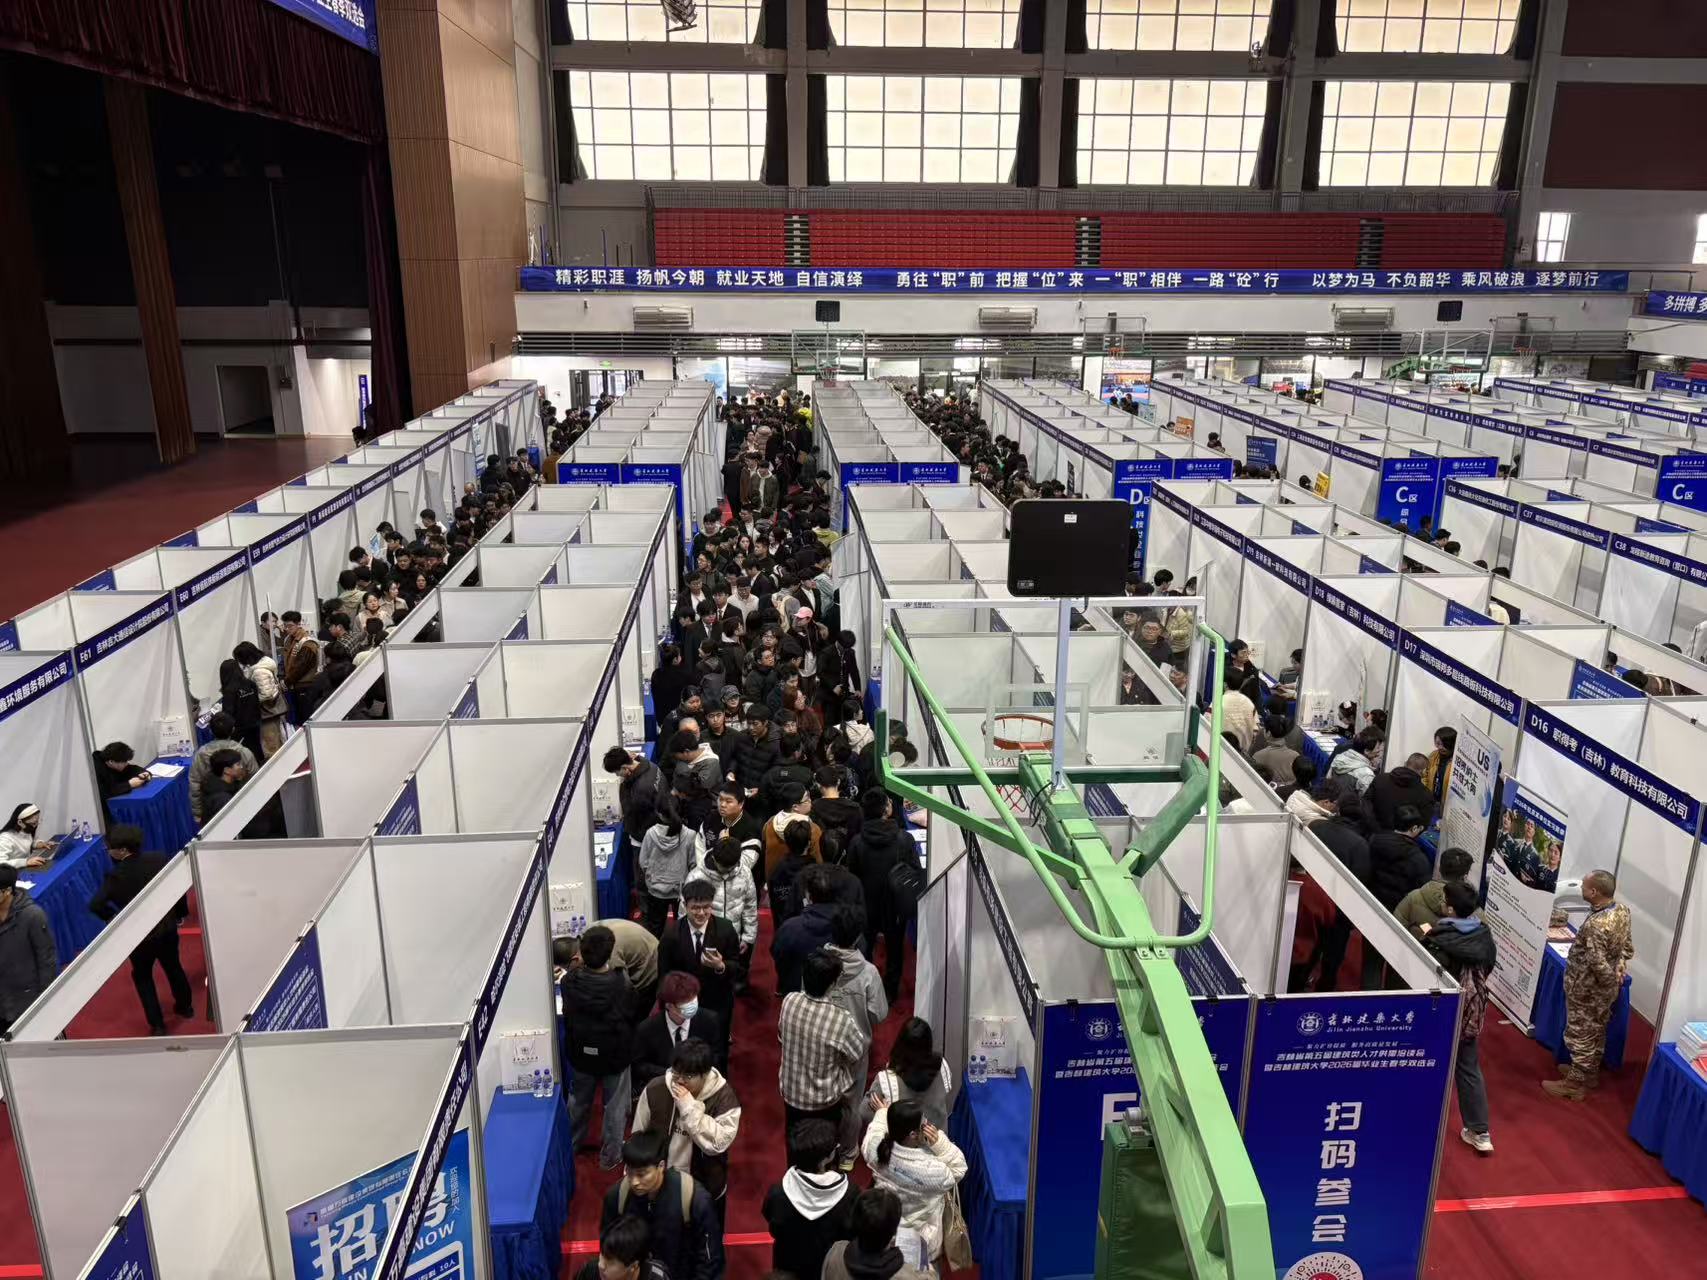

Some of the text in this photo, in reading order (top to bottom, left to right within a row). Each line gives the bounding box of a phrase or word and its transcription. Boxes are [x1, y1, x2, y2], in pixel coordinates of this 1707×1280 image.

[555, 268, 1599, 288] 精彩职涯 扬帆今朝 就业天地 自信演绎 勇往“职”前 把握“位”来 一“职”相伴 一路“砼”行 以梦为马 不负韶华 乘风破浪 逐梦前行
[1664, 295, 1697, 312] 多拼搏
[1523, 509, 1533, 518] C37
[1614, 540, 1626, 551] C38
[1404, 639, 1418, 654] D17
[80, 648, 92, 664] E61
[1477, 748, 1490, 772] US
[1531, 713, 1689, 822] D16 职得考（吉林）教育科技有限公司
[1326, 1024, 1412, 1033] Jilin Jianzhu University
[1311, 1101, 1363, 1243] 扫码参会
